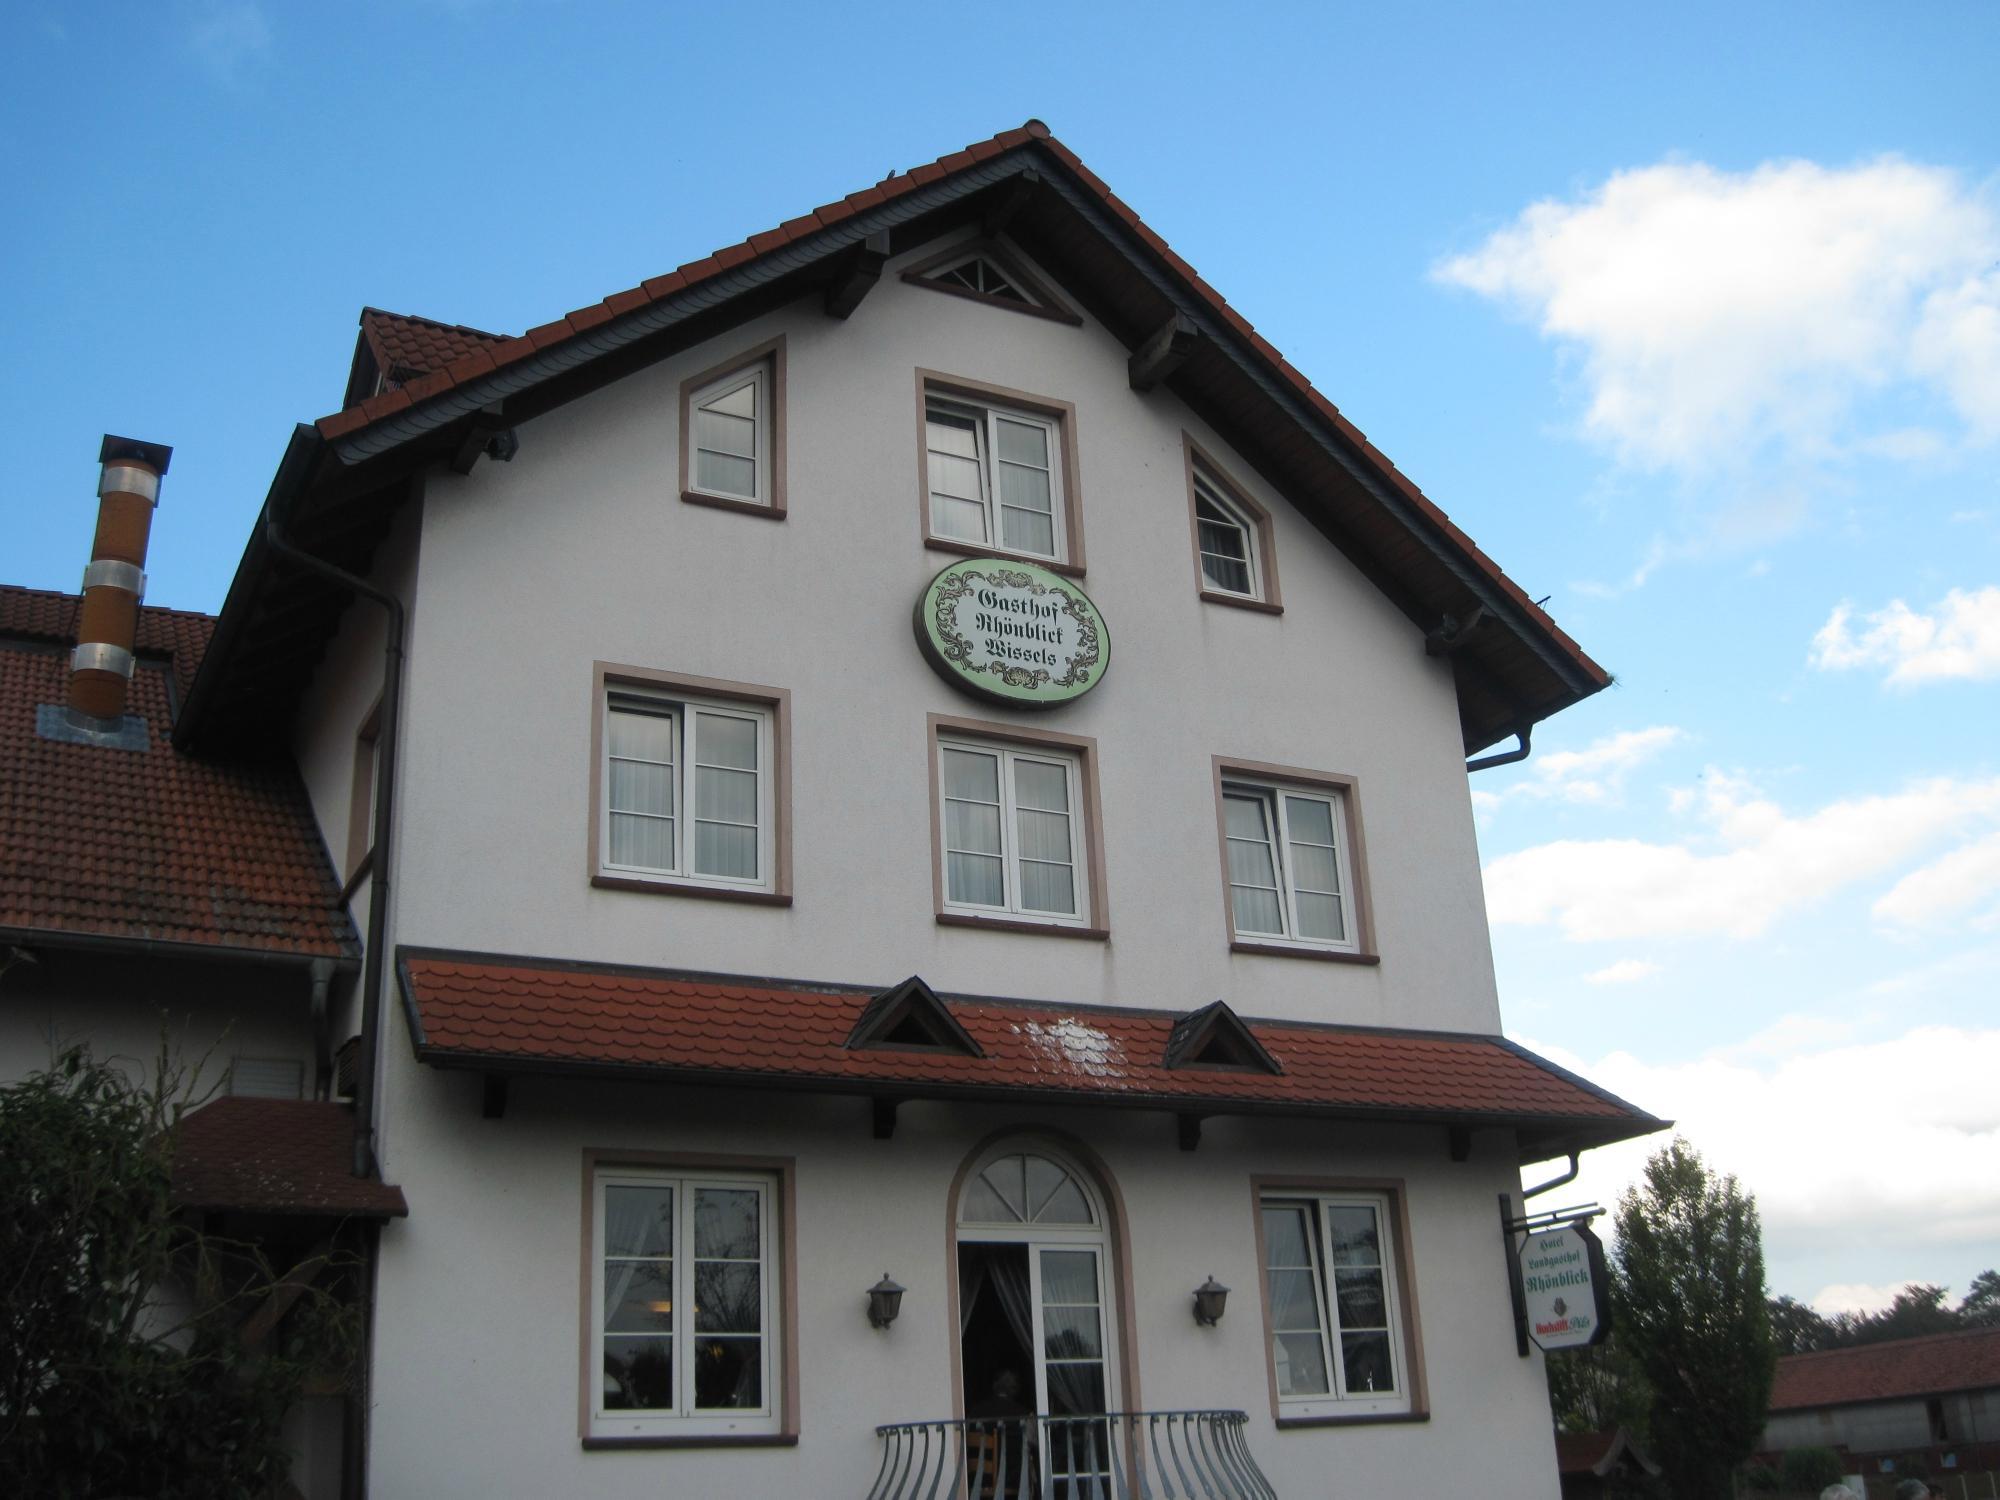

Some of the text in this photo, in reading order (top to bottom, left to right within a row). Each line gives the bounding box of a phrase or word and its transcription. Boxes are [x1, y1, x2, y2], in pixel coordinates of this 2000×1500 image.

[977, 589, 1059, 626] Gasthof
[975, 613, 1064, 645] Rhönblick
[985, 638, 1057, 666] Wissels
[1526, 1268, 1589, 1293] Rhönblick
